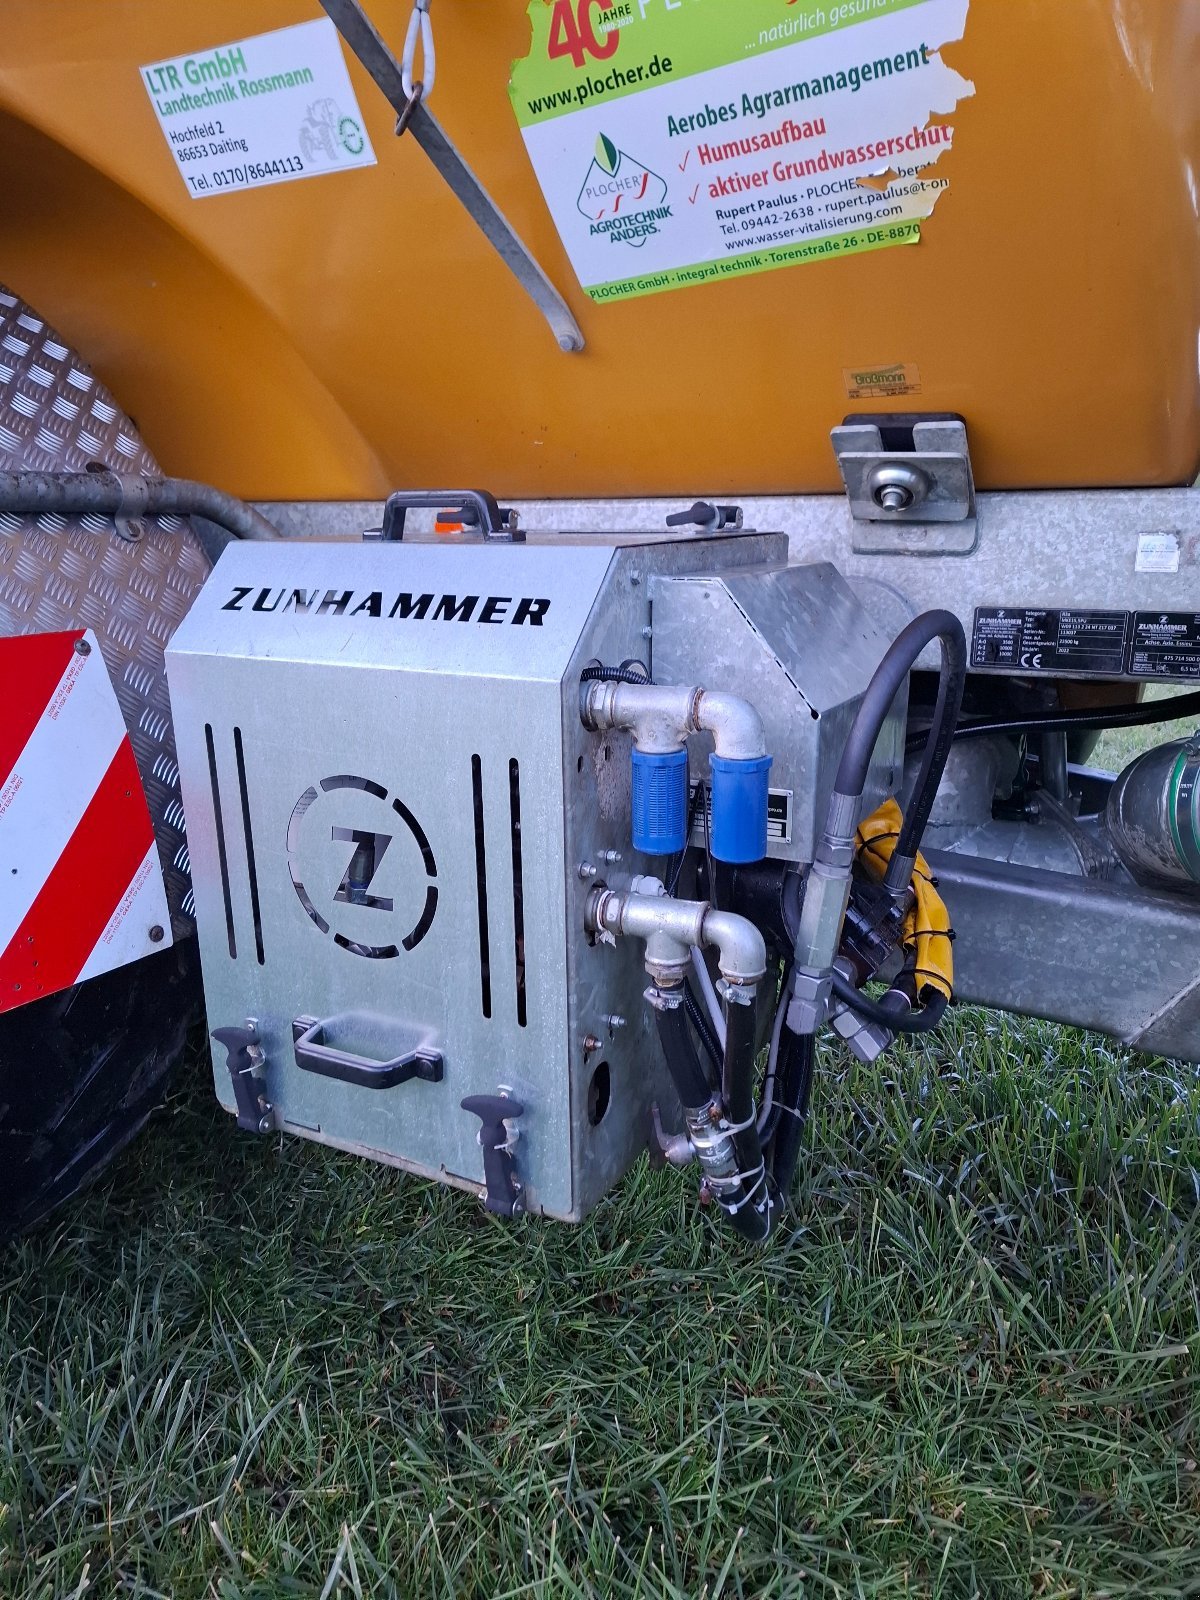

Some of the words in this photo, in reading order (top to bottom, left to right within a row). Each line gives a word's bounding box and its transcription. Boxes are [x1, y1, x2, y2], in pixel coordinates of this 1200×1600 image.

[598, 3, 632, 25] JAHRE
[599, 16, 634, 34] 1980-2020
[758, 6, 827, 46] natürlich
[146, 65, 183, 96] LTR
[184, 47, 248, 86] GmbH
[528, 54, 673, 114] www.plocher.de
[667, 103, 738, 137] Aerobes
[741, 42, 930, 119] Agrarmanagement
[156, 81, 239, 117] Landtechnik
[240, 66, 314, 98] Rossmann
[169, 123, 215, 145] Hochfeld
[216, 121, 225, 134] 2
[177, 144, 209, 163] 86653
[210, 138, 249, 155] Daiting
[697, 117, 827, 166] Humusaufbau
[188, 176, 214, 192] Tel.
[213, 155, 304, 187] 0170/8644113
[586, 175, 640, 199] PLOCHER
[708, 170, 769, 199] aktiver
[589, 205, 674, 236] AGROTECHNIK
[715, 201, 757, 221] Rupert
[757, 193, 798, 211] Paulus
[720, 224, 740, 236] Tel.
[741, 206, 815, 232] 09442-2638
[725, 205, 903, 250] www.wasser-vitalisierung.com
[589, 282, 637, 300] PLOCHER
[638, 275, 671, 290] GmbH
[677, 264, 718, 283] integral
[720, 256, 762, 273] technik
[769, 241, 841, 264] Torenstraße
[843, 236, 858, 249] 26
[221, 586, 552, 626] ZUNHAMMER
[331, 825, 394, 912] Z
